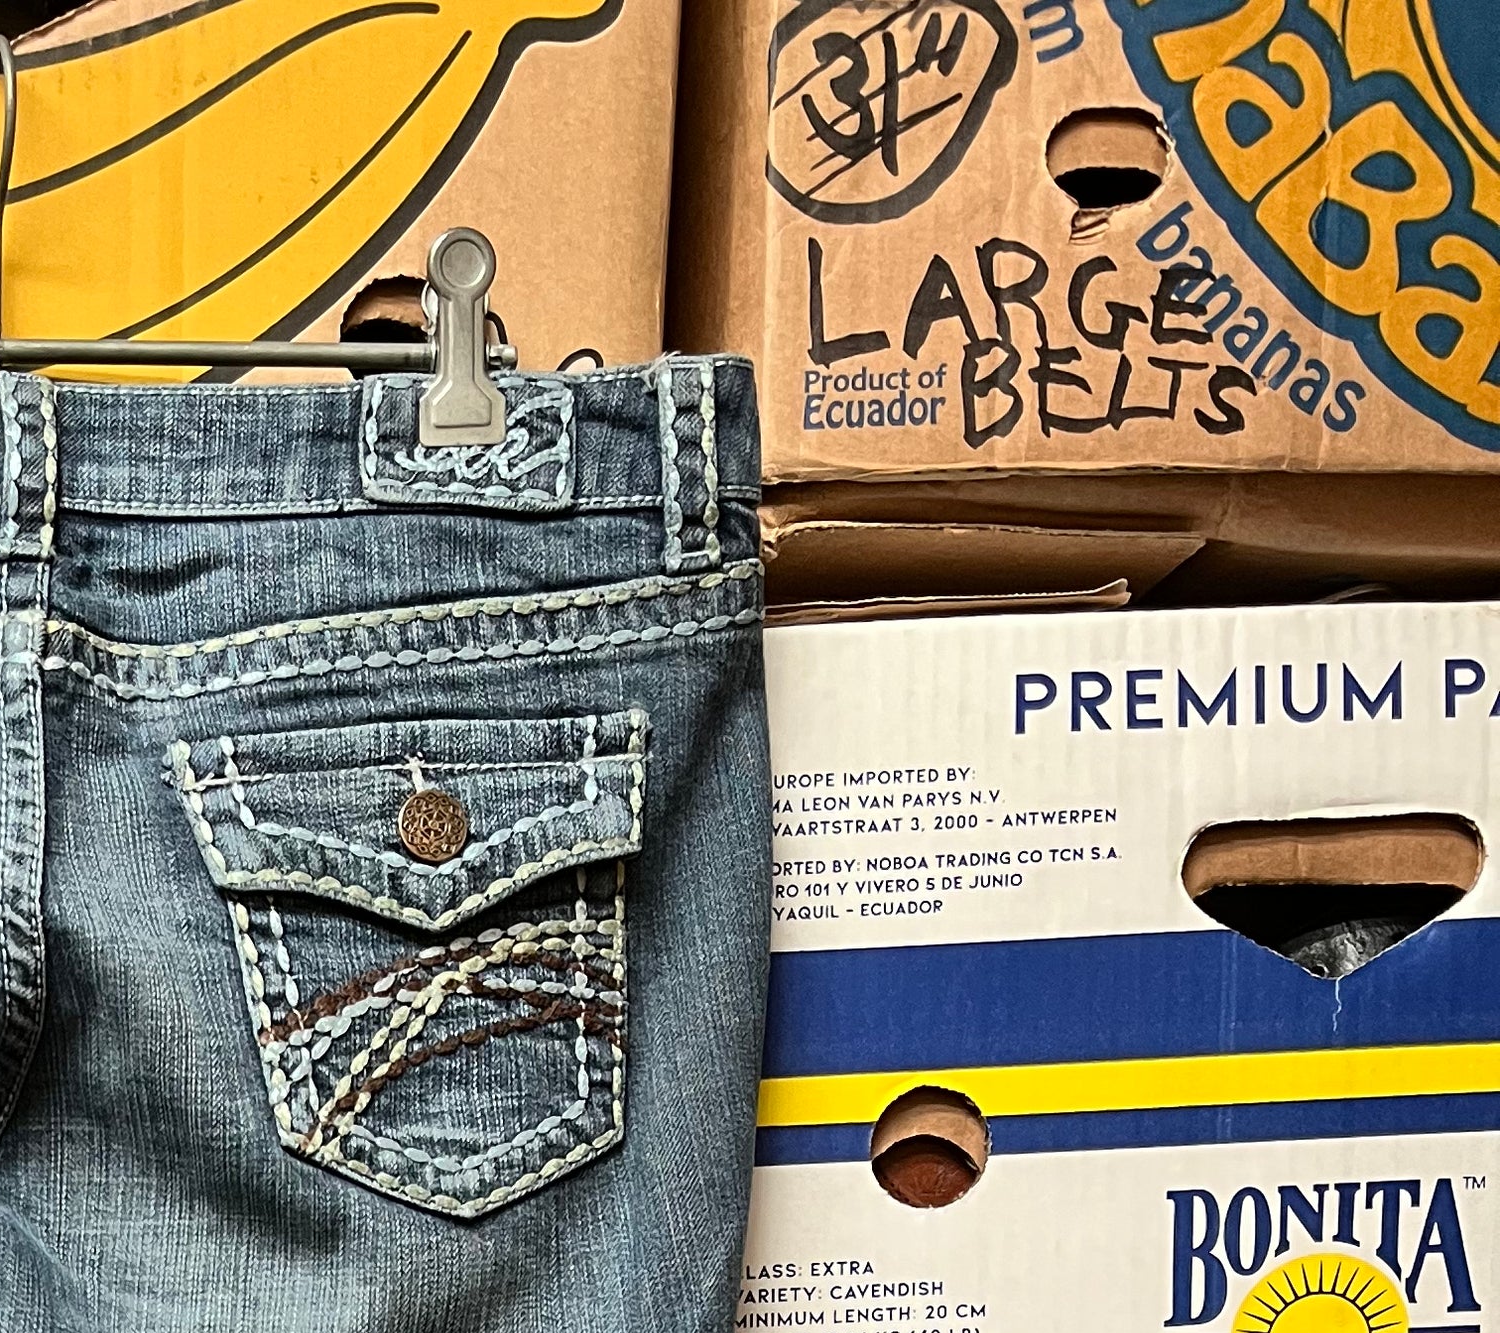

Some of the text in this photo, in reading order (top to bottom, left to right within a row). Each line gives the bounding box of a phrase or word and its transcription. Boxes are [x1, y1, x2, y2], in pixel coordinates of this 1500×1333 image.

[807, 236, 1216, 369] LARGE
[1135, 201, 1368, 433] bananas
[803, 365, 947, 393] Product of
[961, 337, 1257, 449] BELTS
[803, 392, 946, 431] Ecuador
[1014, 661, 1402, 735] PREMIUM
[843, 769, 939, 787] IMPORTED
[801, 791, 962, 813] LEON VAN PARYS
[934, 808, 1117, 831] 2000 ANTWERPEN
[866, 848, 1084, 872] NOBOA TRADING CO TCN
[804, 873, 1023, 898] 101 VIVERO DE JUNIO
[860, 900, 943, 917] ECUADOR
[1164, 1178, 1482, 1329] BONITA
[810, 1261, 874, 1276] EXTRA
[829, 1281, 944, 1300] CAVENDISH
[735, 1304, 986, 1329] MINIMUM 20 CM
